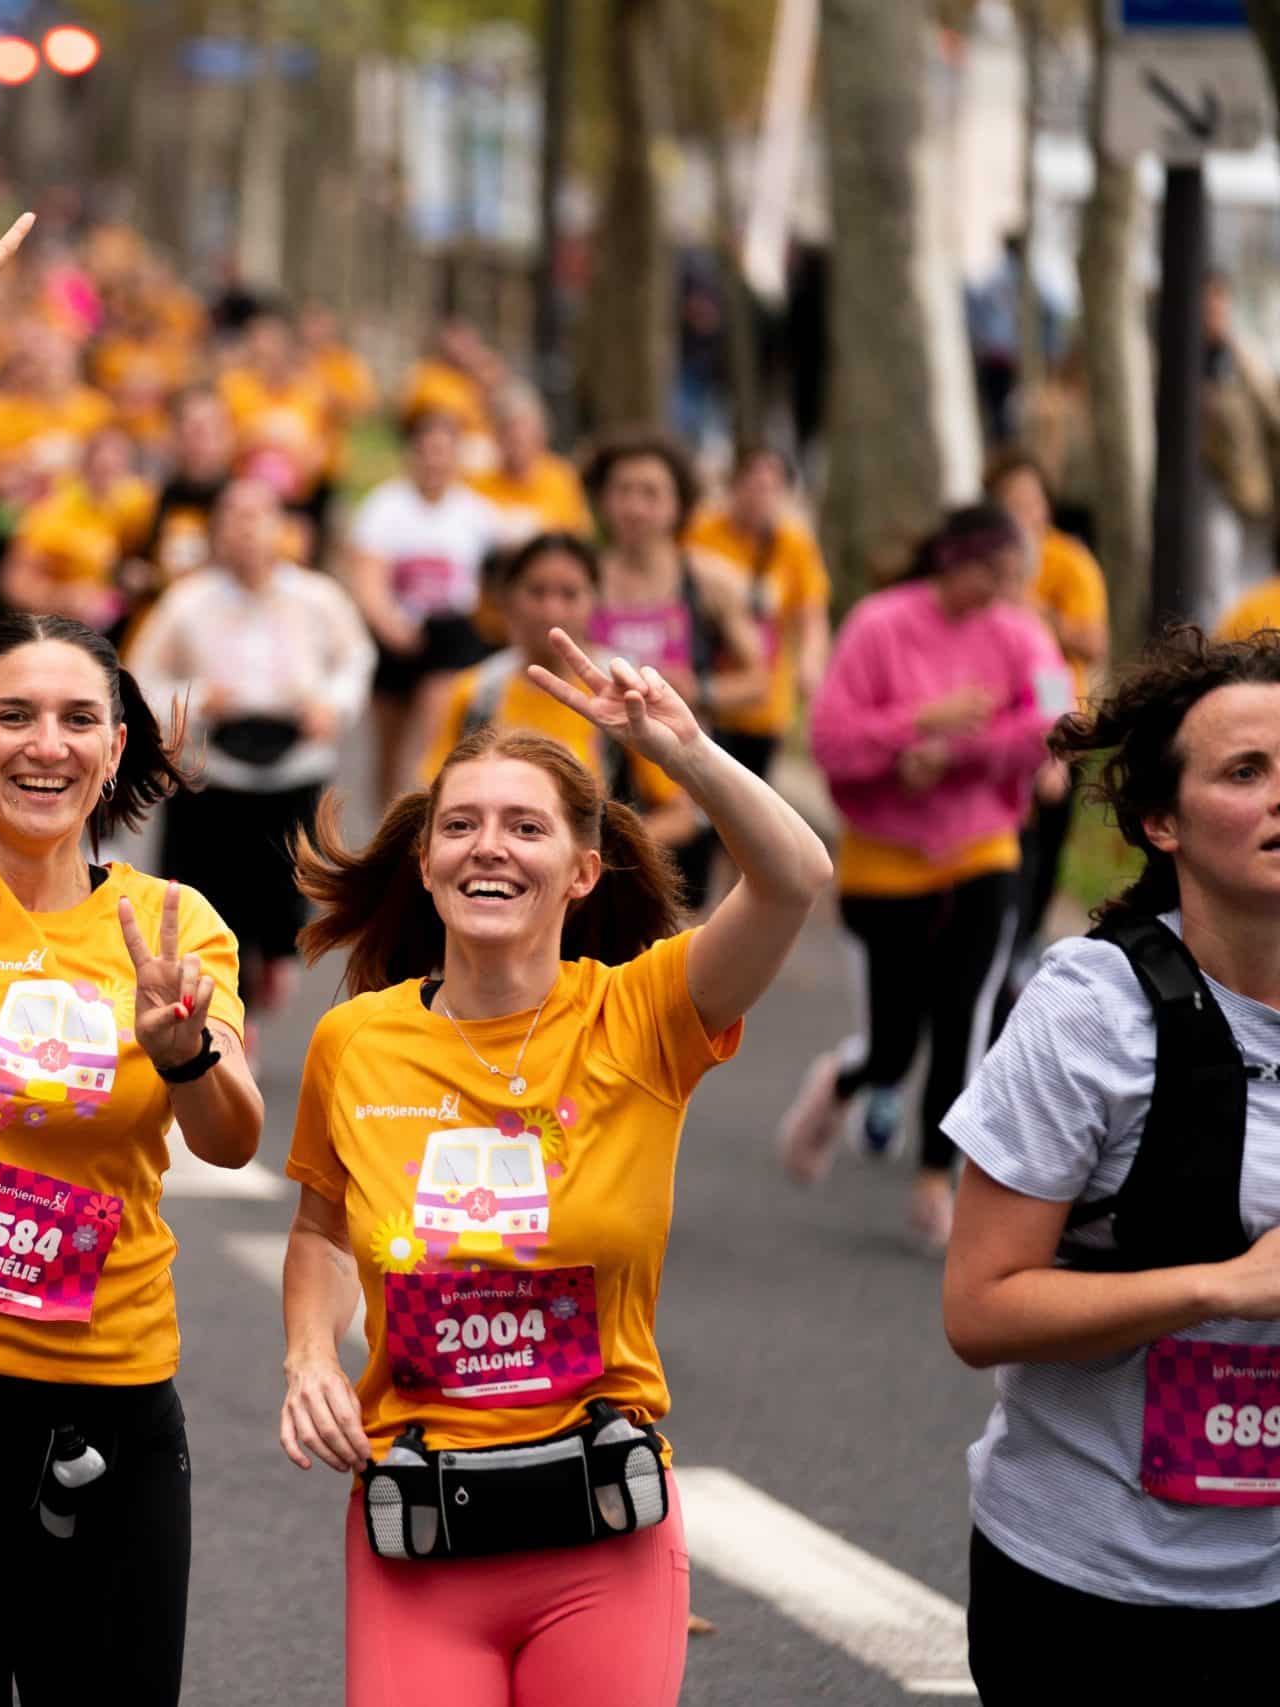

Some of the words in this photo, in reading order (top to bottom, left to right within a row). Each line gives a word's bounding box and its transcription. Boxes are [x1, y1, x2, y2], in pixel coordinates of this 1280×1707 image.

[366, 1103, 438, 1120] Parisienne
[452, 1287, 515, 1301] Parisienne
[435, 1309, 546, 1353] 2004
[455, 1344, 535, 1375] SALOMÉ
